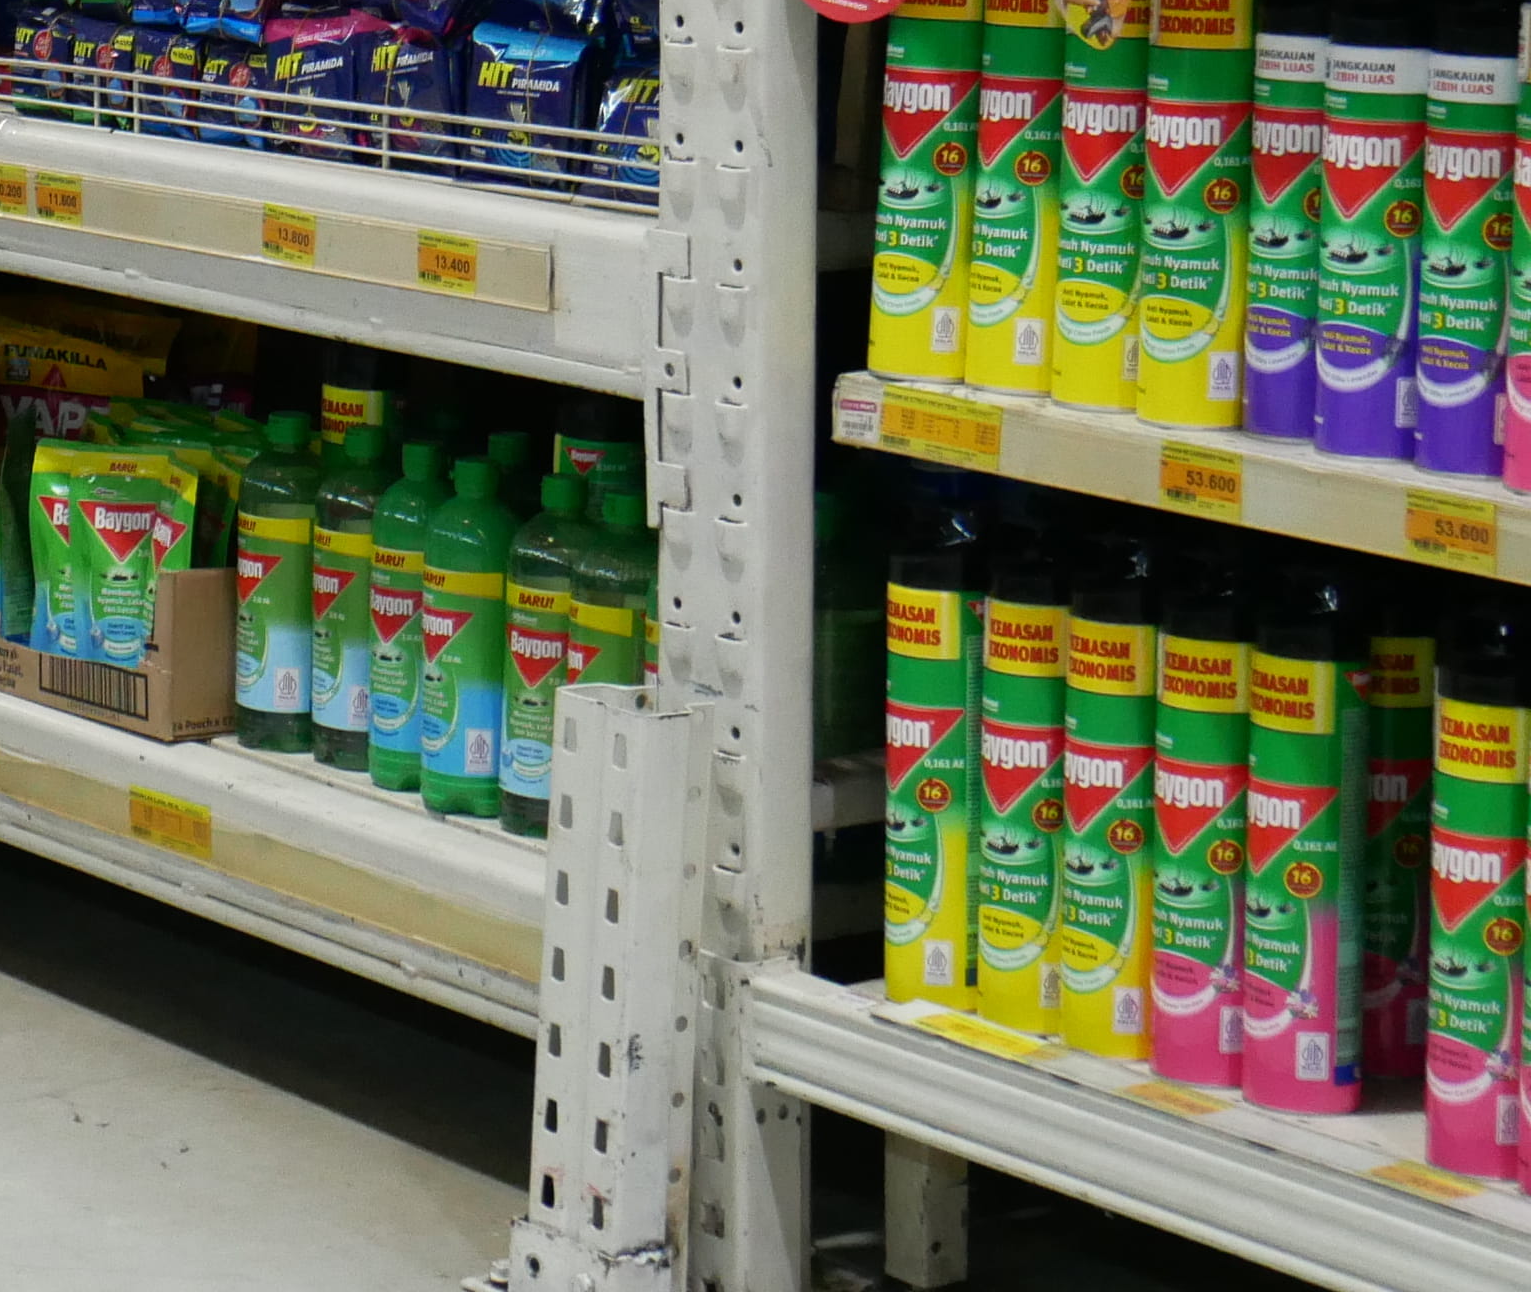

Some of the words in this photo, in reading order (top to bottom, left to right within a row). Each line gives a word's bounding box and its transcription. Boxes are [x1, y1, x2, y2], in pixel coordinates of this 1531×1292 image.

[15, 28, 34, 44] HIT
[1159, 16, 1235, 36] EKONOMIS
[74, 40, 94, 58] HIT
[371, 44, 401, 72] HIT
[203, 59, 229, 76] HIT
[274, 52, 304, 82] HIT
[300, 57, 344, 75] PIRAMIDA
[478, 61, 515, 88] HIT
[511, 77, 561, 93] PIRAMIDA
[1283, 62, 1315, 73] LUAS
[1362, 73, 1395, 85] LUAS
[1461, 83, 1494, 95] LUAS
[940, 150, 959, 163] 16
[894, 215, 947, 231] Nyamuk
[435, 254, 470, 274] 13.400
[4, 344, 108, 371] FUMAKILLA
[110, 462, 138, 472] BARU!
[1186, 470, 1236, 494] 53.600
[95, 507, 151, 533] Baygon
[1435, 519, 1489, 545] 53.600
[375, 552, 405, 568] BARU!
[518, 592, 555, 610] BARU!
[991, 619, 1053, 642] KEMASAN
[510, 634, 563, 663] Baygon
[1070, 636, 1131, 659] KEMASAN
[1164, 652, 1232, 676] KEMASAN
[1251, 670, 1309, 695] KEMASAN
[1441, 718, 1511, 744] KEMASAN
[1252, 934, 1300, 955] Nyamuk
[1445, 994, 1501, 1015] Nyamuk
